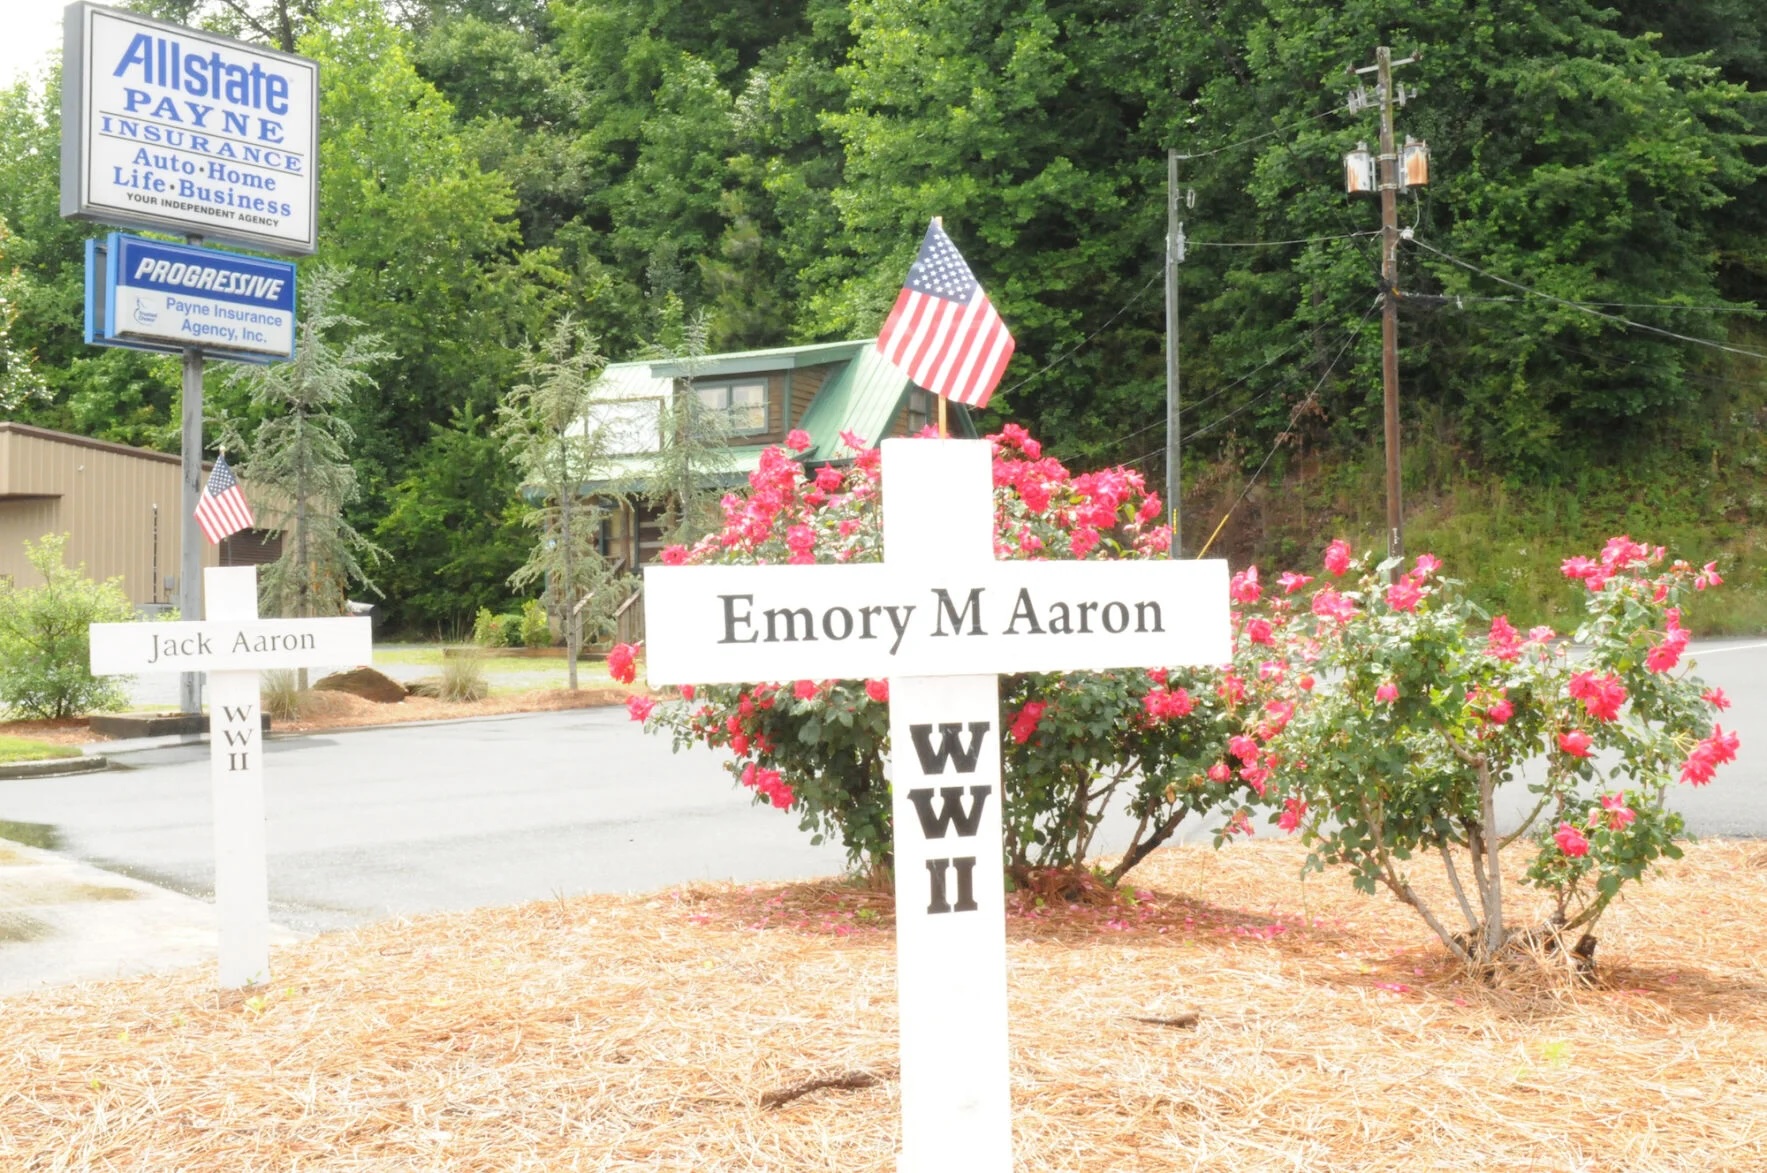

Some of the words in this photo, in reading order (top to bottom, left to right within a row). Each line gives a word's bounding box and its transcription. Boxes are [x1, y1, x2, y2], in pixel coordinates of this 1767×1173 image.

[113, 33, 289, 116] Allstate
[124, 88, 285, 145] PAYNE
[101, 116, 302, 172] INSURANCE
[126, 192, 158, 206] YOUR
[160, 199, 235, 221] INDEPENDENT
[238, 212, 280, 228] AGENCY
[134, 257, 285, 301] PROGRESSIVE
[166, 297, 210, 317] Payne
[214, 305, 283, 327] Insurance
[181, 318, 239, 341] Agency,
[242, 328, 268, 344] Inc.
[717, 593, 916, 656] Emory
[931, 587, 989, 637] M
[1002, 587, 1166, 635] Aaron
[147, 632, 213, 664] Jack
[231, 630, 316, 654] Aaron
